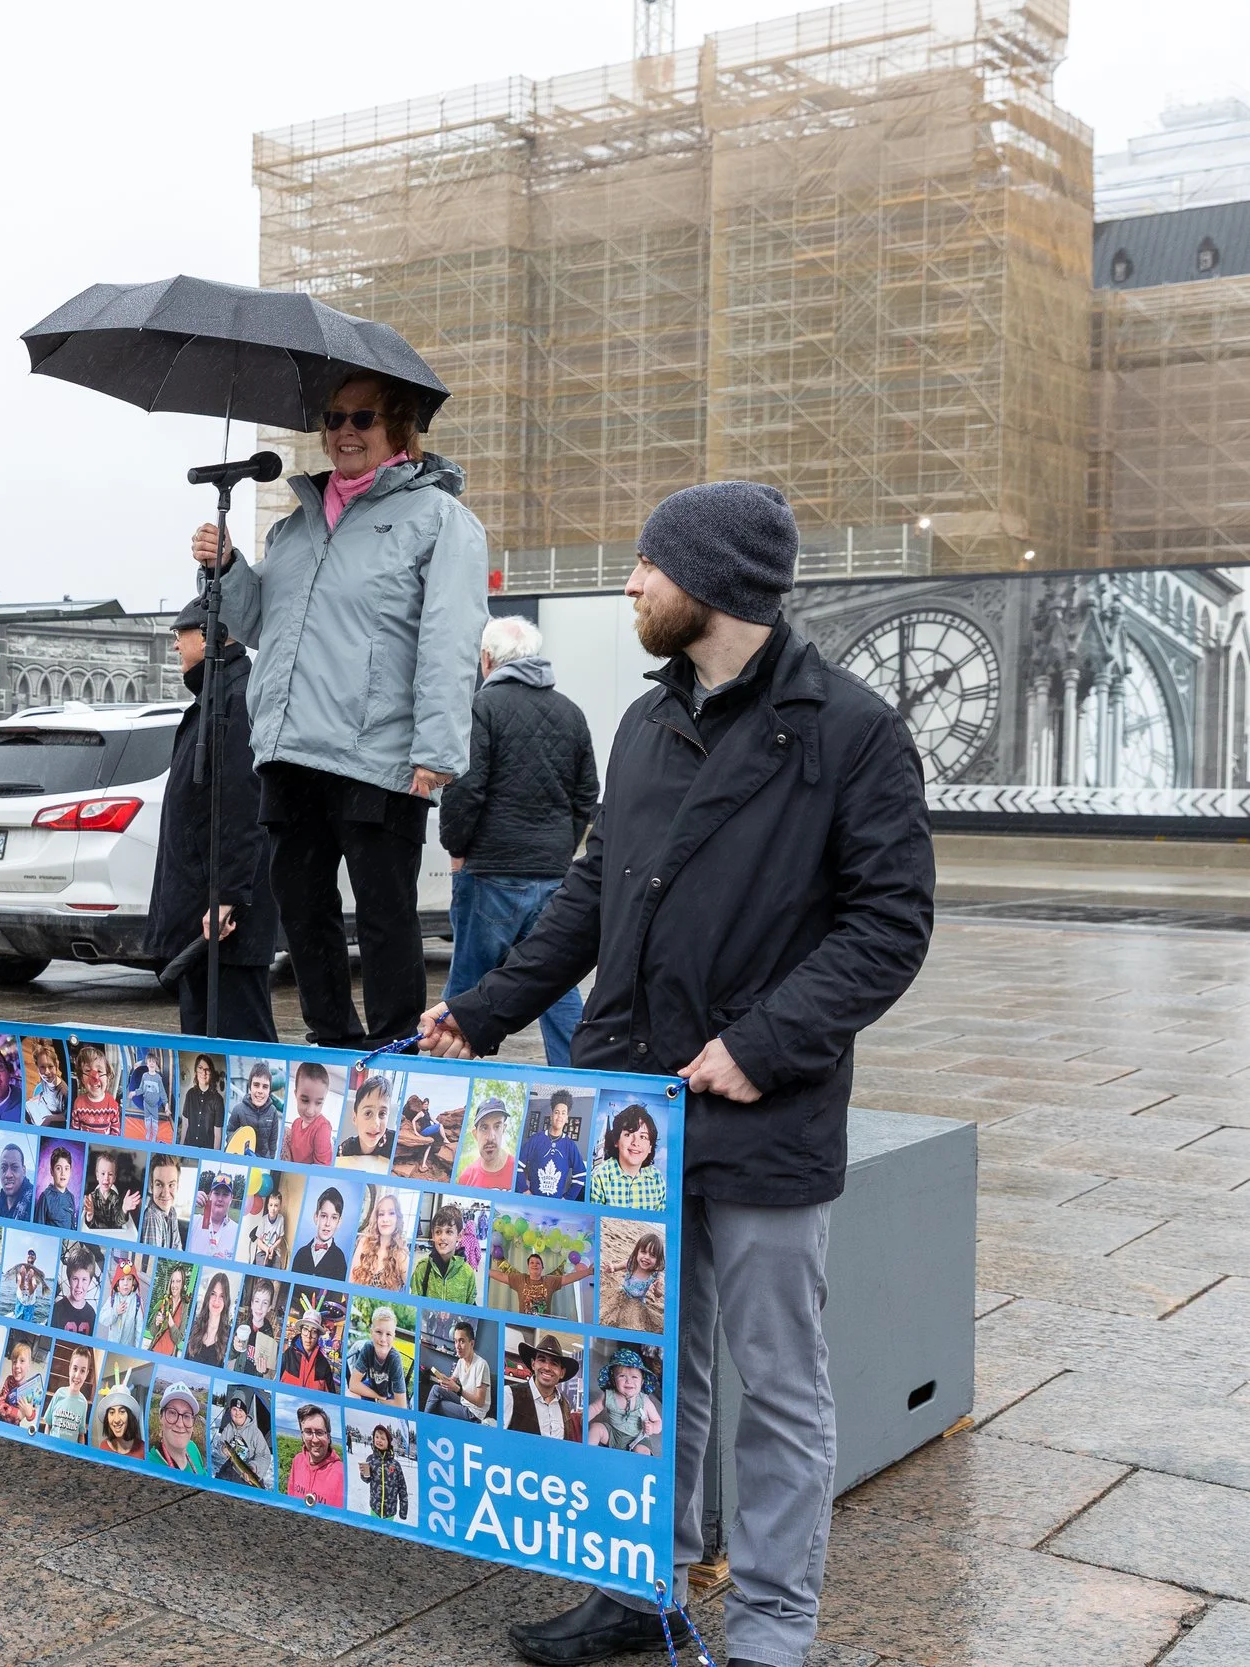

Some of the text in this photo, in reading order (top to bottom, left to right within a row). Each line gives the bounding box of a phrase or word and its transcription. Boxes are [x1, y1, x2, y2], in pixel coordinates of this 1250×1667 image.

[427, 1437, 455, 1538] 2026
[463, 1443, 656, 1525] Faces of
[464, 1489, 655, 1584] Autism
